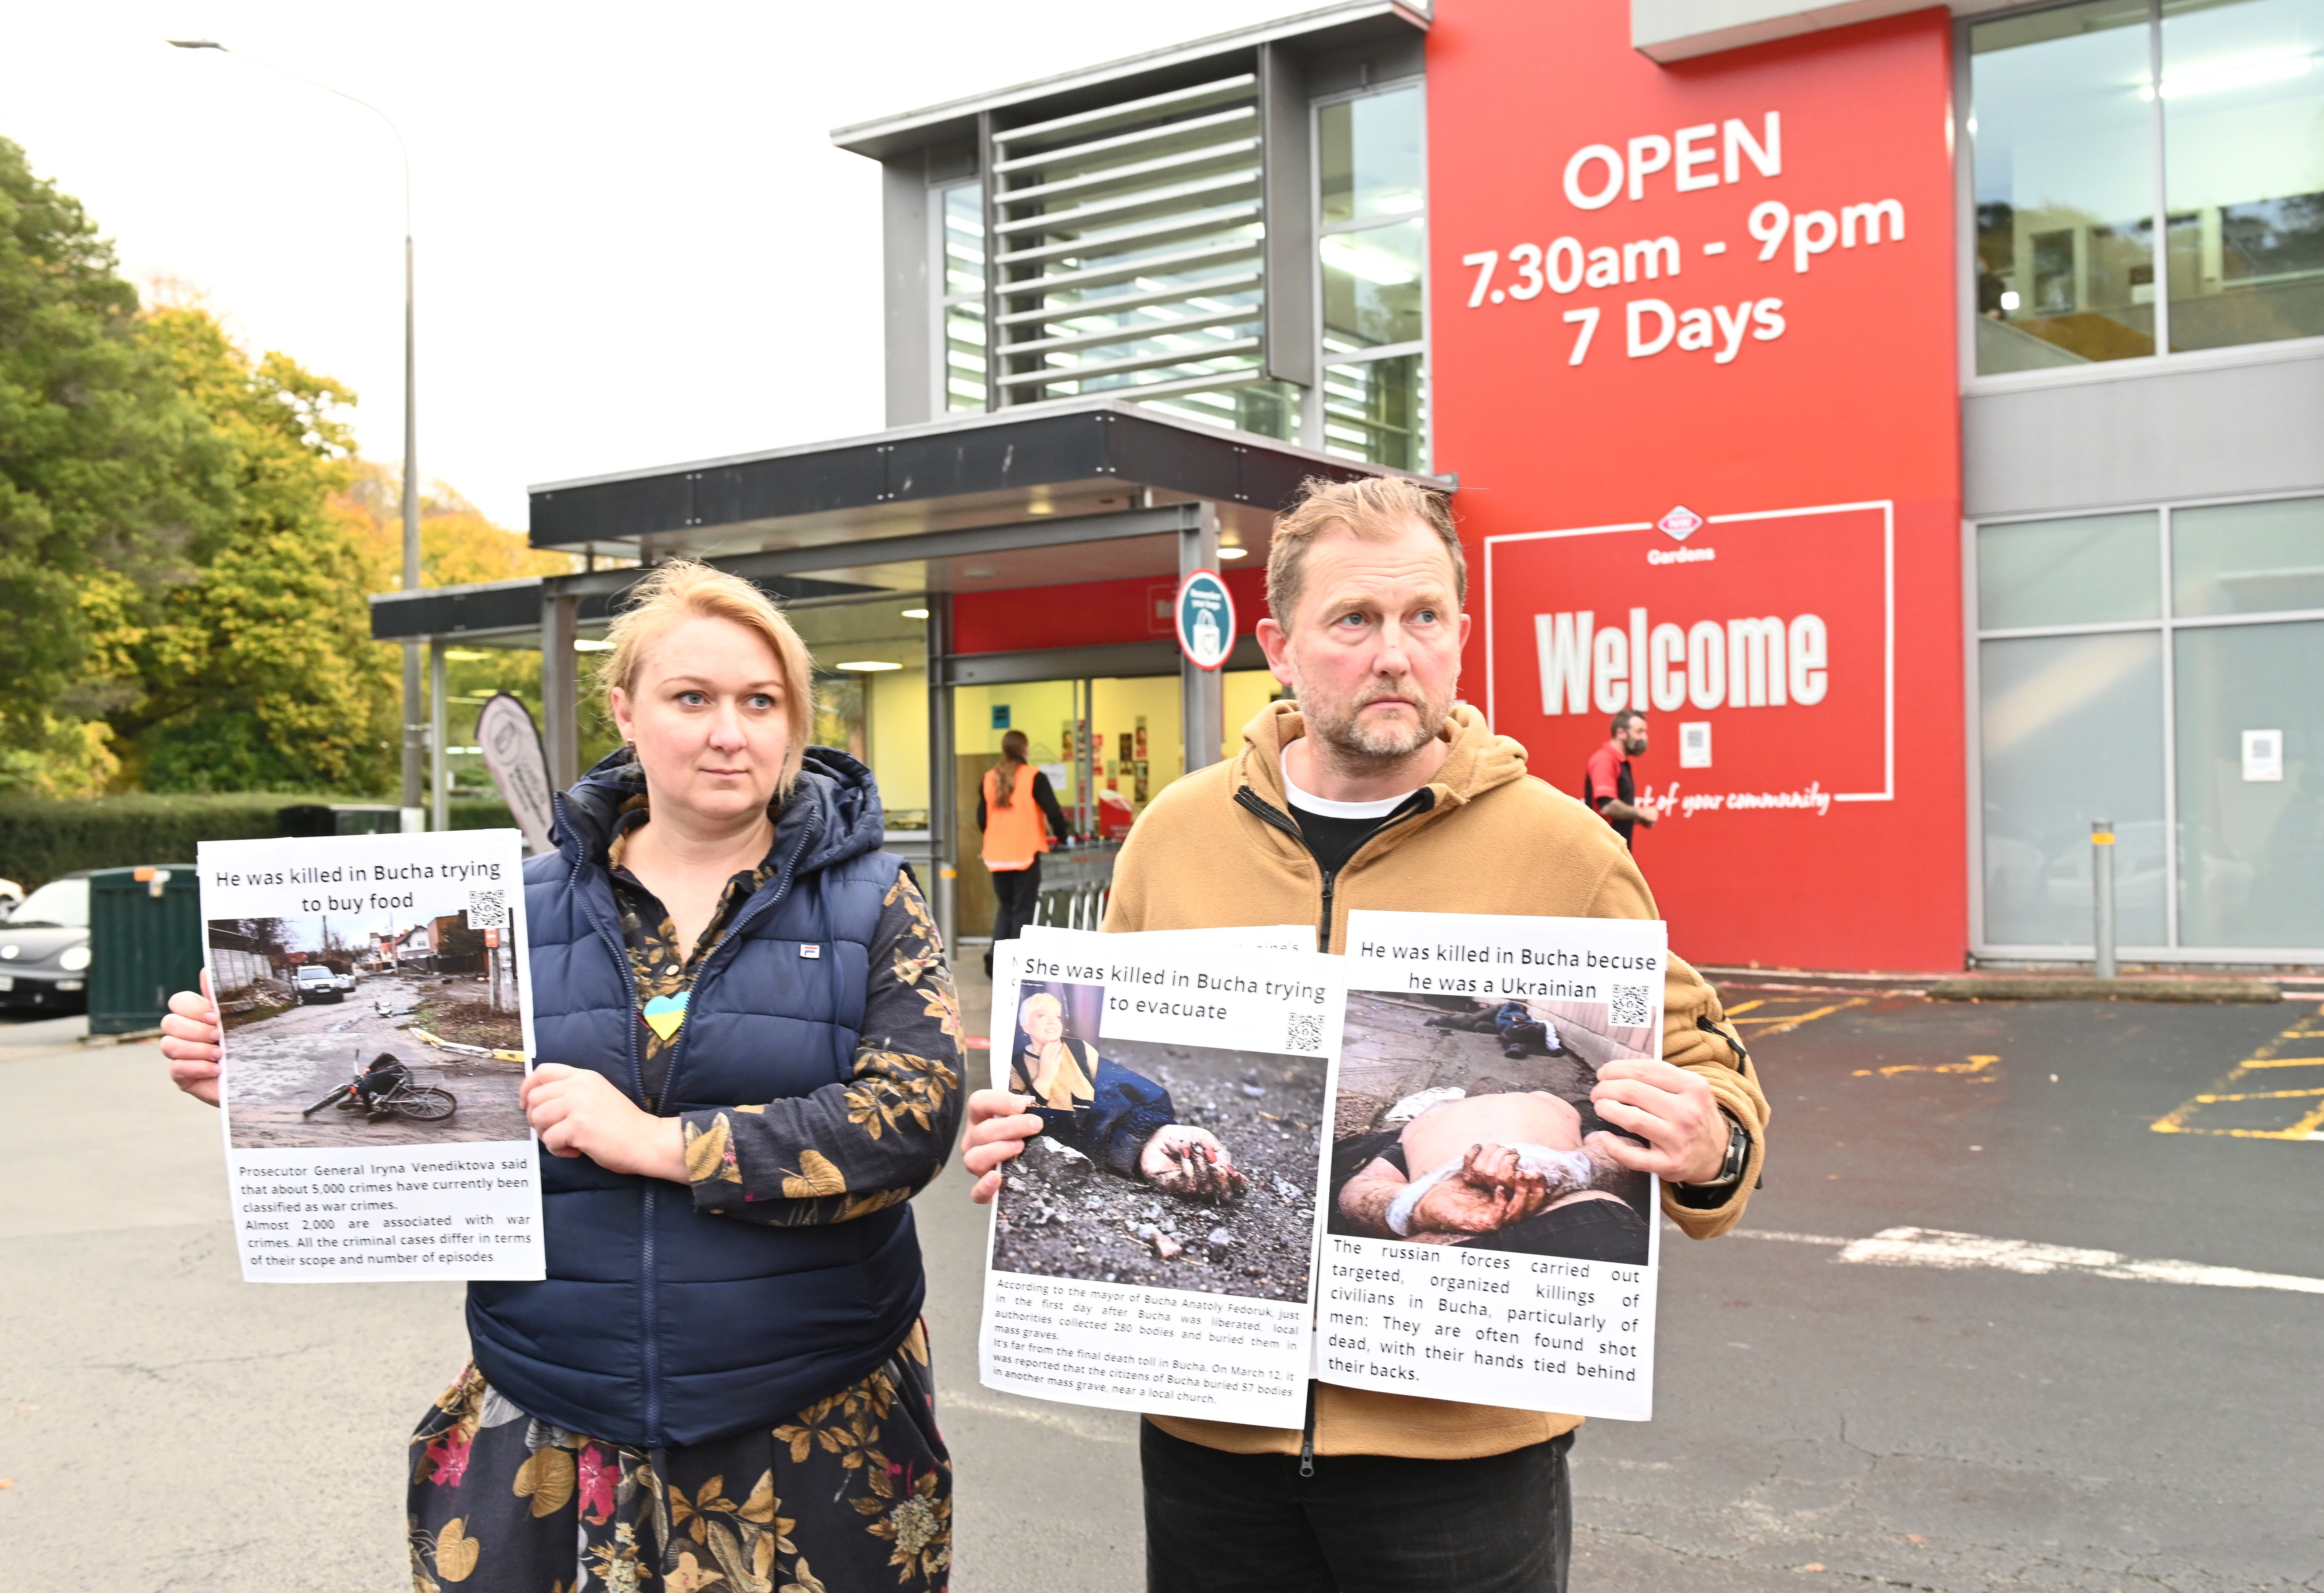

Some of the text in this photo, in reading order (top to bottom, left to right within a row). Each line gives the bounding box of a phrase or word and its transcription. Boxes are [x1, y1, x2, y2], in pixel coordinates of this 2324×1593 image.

[1564, 110, 1782, 210] OPEN
[1462, 198, 1905, 308] 7.30am - 9pm
[1563, 297, 1786, 366] 7 Days
[1534, 607, 1828, 715] Welcome
[1657, 781, 1680, 817] of
[1682, 794, 1724, 818] your
[1726, 781, 1831, 816] community
[216, 861, 501, 887] He was killed in Bucha trying
[302, 892, 413, 914] to buy food
[1361, 942, 1656, 971] He was killed in Bucha becuse
[1025, 959, 1326, 1004] She was killed in Bucha trying
[1409, 972, 1596, 998] he was a Ukrainian
[1110, 995, 1227, 1020] to evacuate
[239, 1158, 527, 1177] Prosecutor General Iryna Venediktova said
[241, 1177, 528, 1195] that about 5,000 crimes have currently been
[243, 1200, 398, 1213] classified as war crimes.
[246, 1214, 531, 1230] Almost 2,000 are associated with war
[248, 1233, 531, 1248] crimes. All the criminal cases differ in terms
[250, 1255, 263, 1265] of
[265, 1256, 296, 1265] their
[299, 1257, 336, 1268] scope
[339, 1254, 363, 1264] and
[367, 1253, 418, 1264] number
[422, 1251, 435, 1262] of
[1334, 1239, 1640, 1283] The russian forces carried out
[996, 1279, 1049, 1295] According
[1068, 1288, 1086, 1297] the
[1091, 1291, 1125, 1302] mayor
[1129, 1294, 1141, 1302] of
[1144, 1294, 1177, 1306] Bucha
[1182, 1299, 1223, 1313] Anatoly
[1277, 1309, 1300, 1320] just
[1332, 1264, 1640, 1308] targeted, organized killings of
[996, 1294, 1005, 1303] in
[1015, 1297, 1032, 1306] the
[1042, 1299, 1063, 1310] first
[1073, 1303, 1092, 1315] day
[1102, 1306, 1128, 1316] after
[1138, 1310, 1171, 1321] Bucha
[1181, 1316, 1201, 1324] was
[1273, 1324, 1299, 1335] local
[1331, 1287, 1639, 1333] civilians in Bucha, particularly of
[994, 1325, 1060, 1340] mass graves.
[995, 1311, 1297, 1350] authorities collected 280 bodies and buried them in
[1330, 1313, 1637, 1357] men: They are often found shot
[993, 1354, 1292, 1396] was reported that the citizens of Bucha buried 57 bodies
[1328, 1333, 1635, 1382] dead, with their hands tied behind
[1328, 1357, 1419, 1381] their backs.
[993, 1366, 1002, 1376] in
[1004, 1370, 1044, 1383] another
[1048, 1378, 1074, 1387] mass
[1113, 1386, 1137, 1394] near
[1149, 1388, 1174, 1399] local
